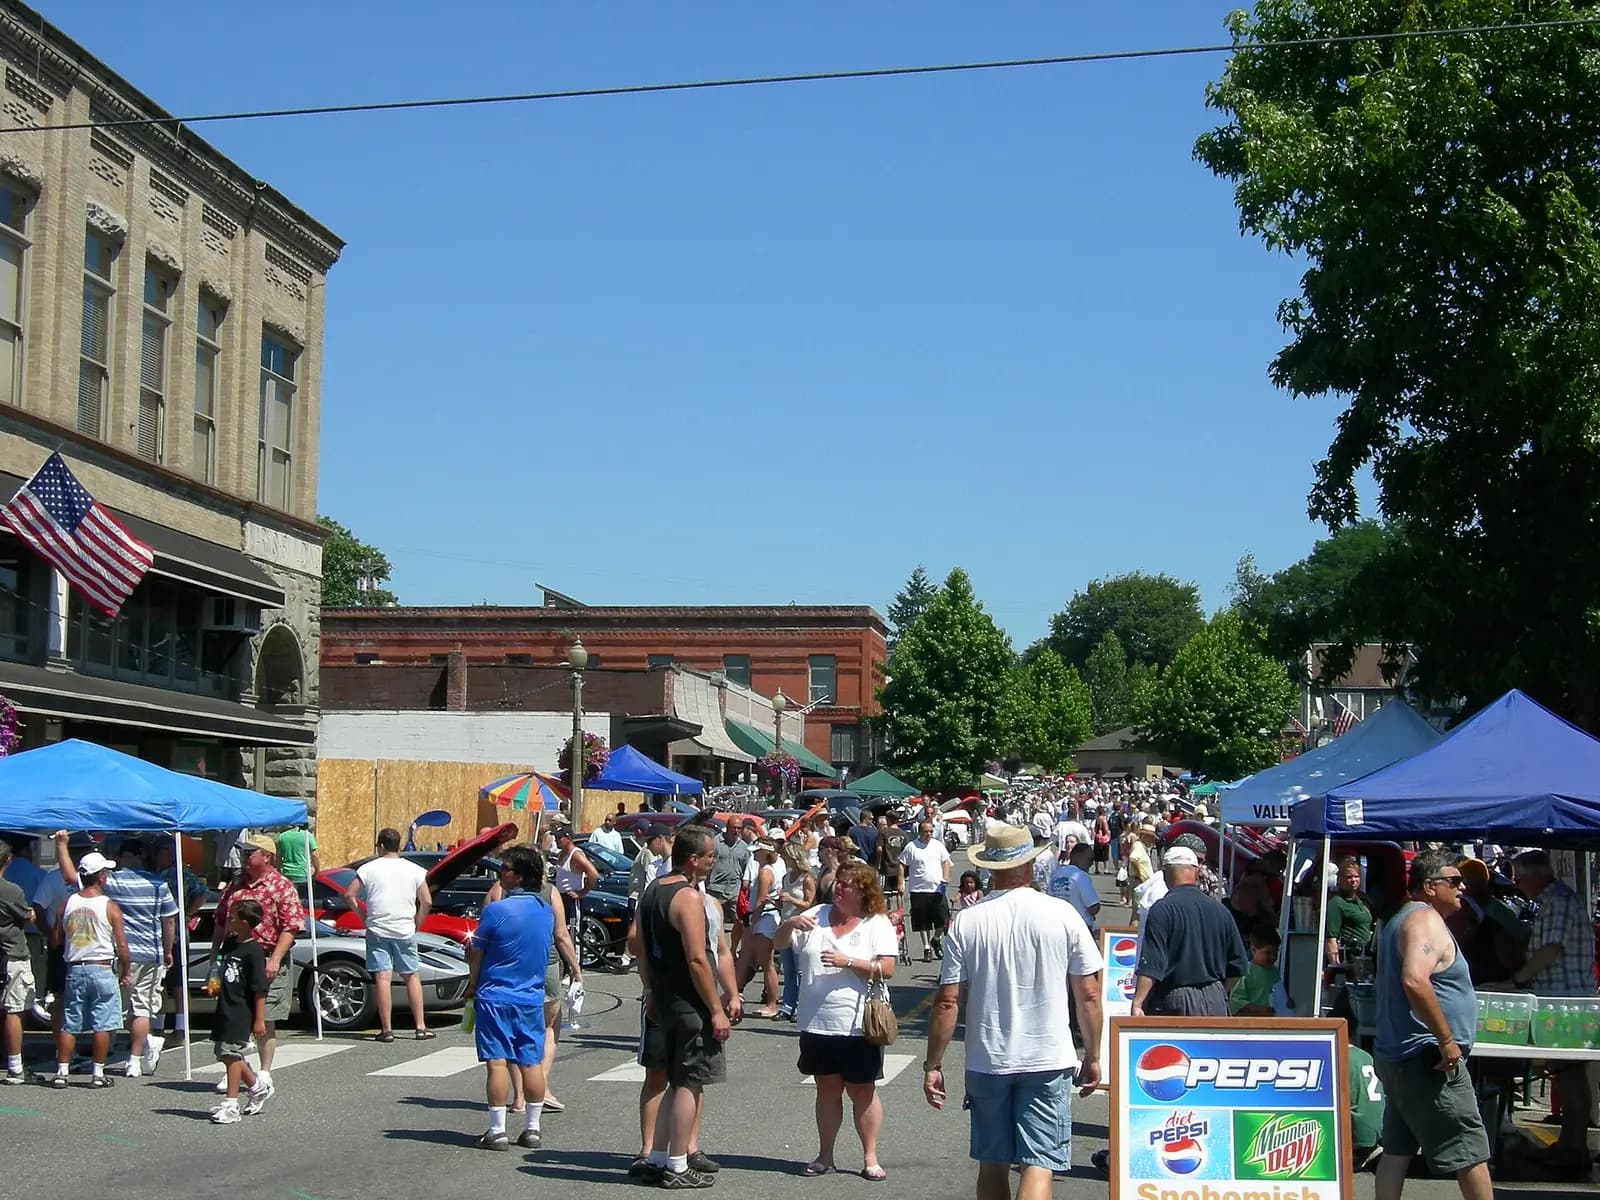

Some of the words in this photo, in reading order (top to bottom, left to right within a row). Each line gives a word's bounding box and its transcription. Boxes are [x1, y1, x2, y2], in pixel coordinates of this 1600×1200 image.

[1184, 1057, 1323, 1090] PEPSI
[1361, 1065, 1382, 1102] 2
[1150, 1122, 1207, 1145] PEPSI
[1165, 1110, 1194, 1128] diet
[1257, 1120, 1317, 1155] Mountain
